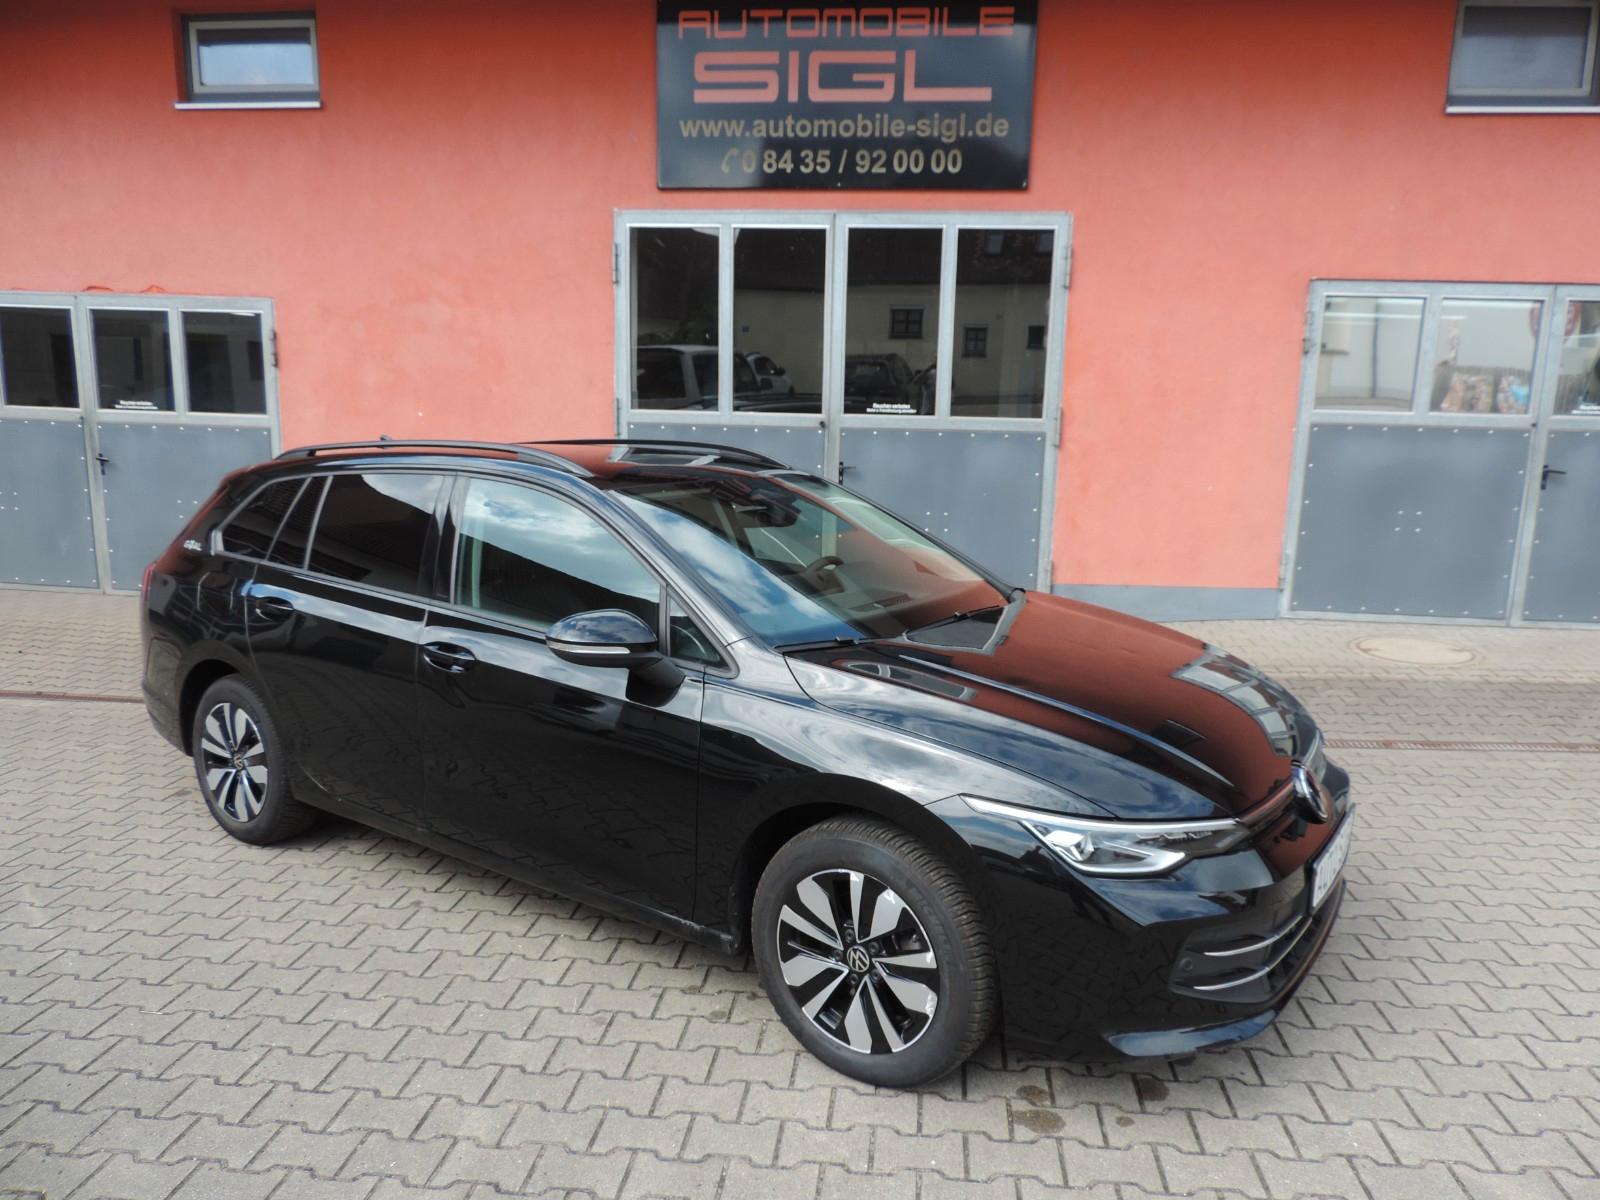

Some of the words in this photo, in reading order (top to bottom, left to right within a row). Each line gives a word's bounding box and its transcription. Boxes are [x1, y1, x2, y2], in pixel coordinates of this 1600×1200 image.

[679, 7, 1014, 38] AUTOMOBILE
[694, 50, 992, 103] SIGL
[680, 114, 1009, 143] www.automobile-sigl.de
[763, 150, 793, 174] 84
[800, 150, 831, 174] 35
[856, 150, 887, 174] 92
[893, 150, 924, 174] 00
[931, 150, 962, 174] 00
